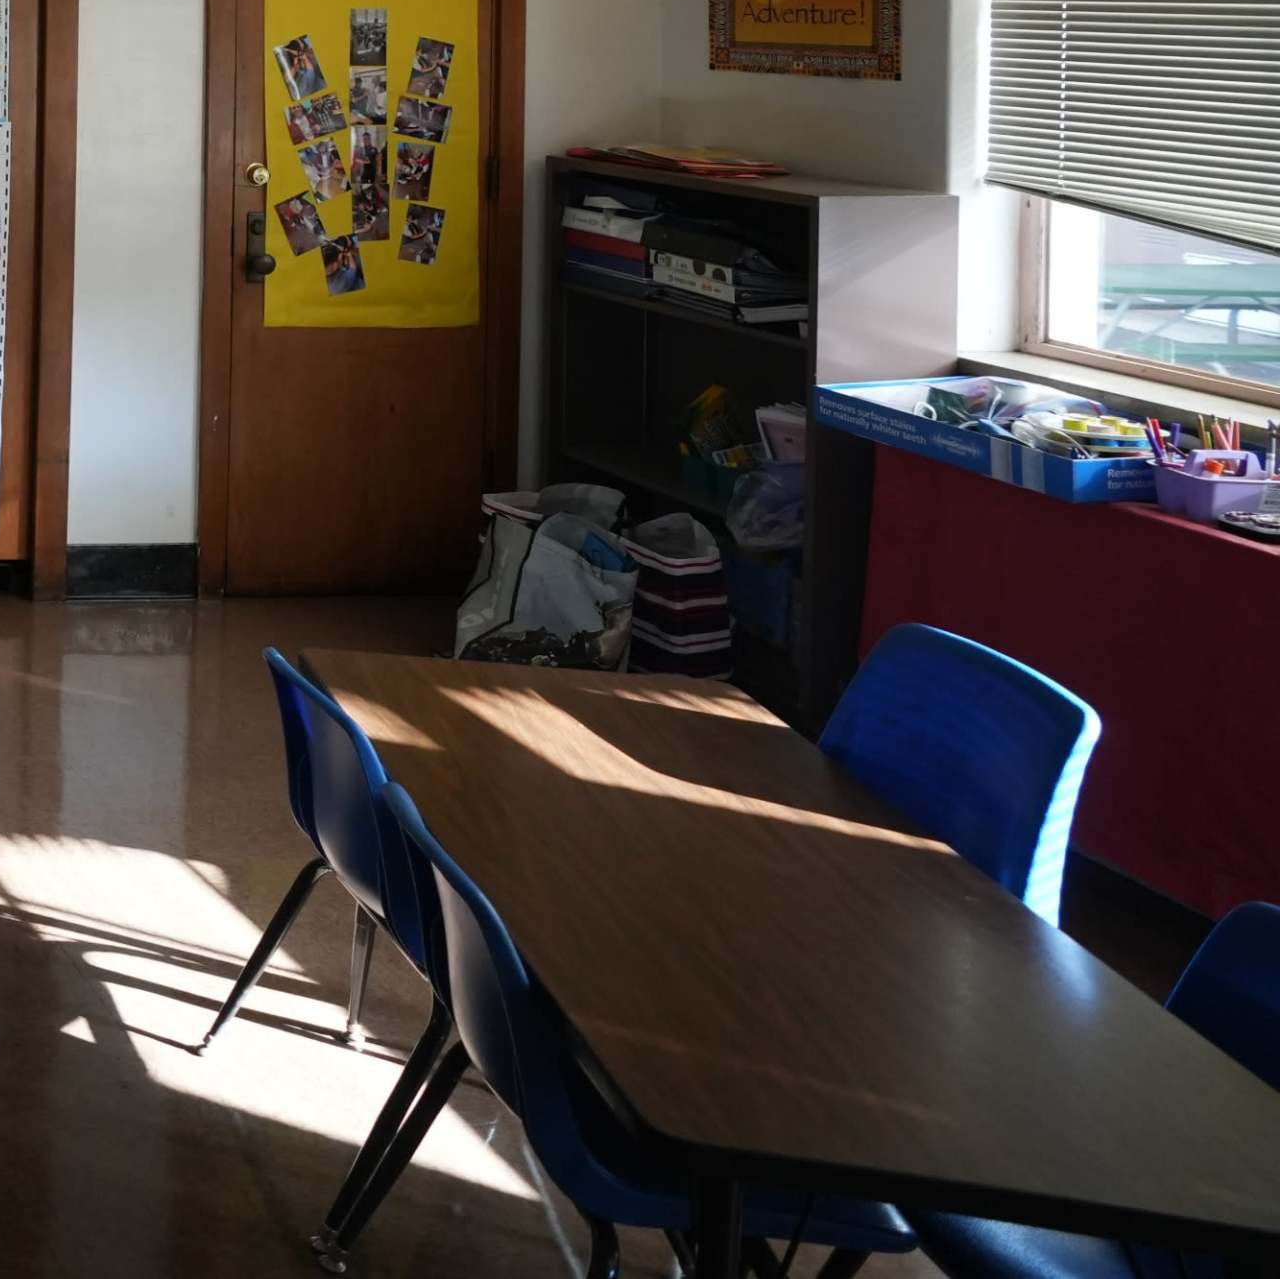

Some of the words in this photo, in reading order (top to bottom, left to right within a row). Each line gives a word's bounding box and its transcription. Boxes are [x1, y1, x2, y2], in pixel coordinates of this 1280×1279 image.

[819, 396, 856, 414] Removes
[858, 408, 888, 423] surface
[819, 406, 831, 417] for
[833, 409, 870, 429] naturally
[872, 421, 900, 438] whiter
[902, 431, 927, 445] teeth
[1107, 479, 1122, 489] for
